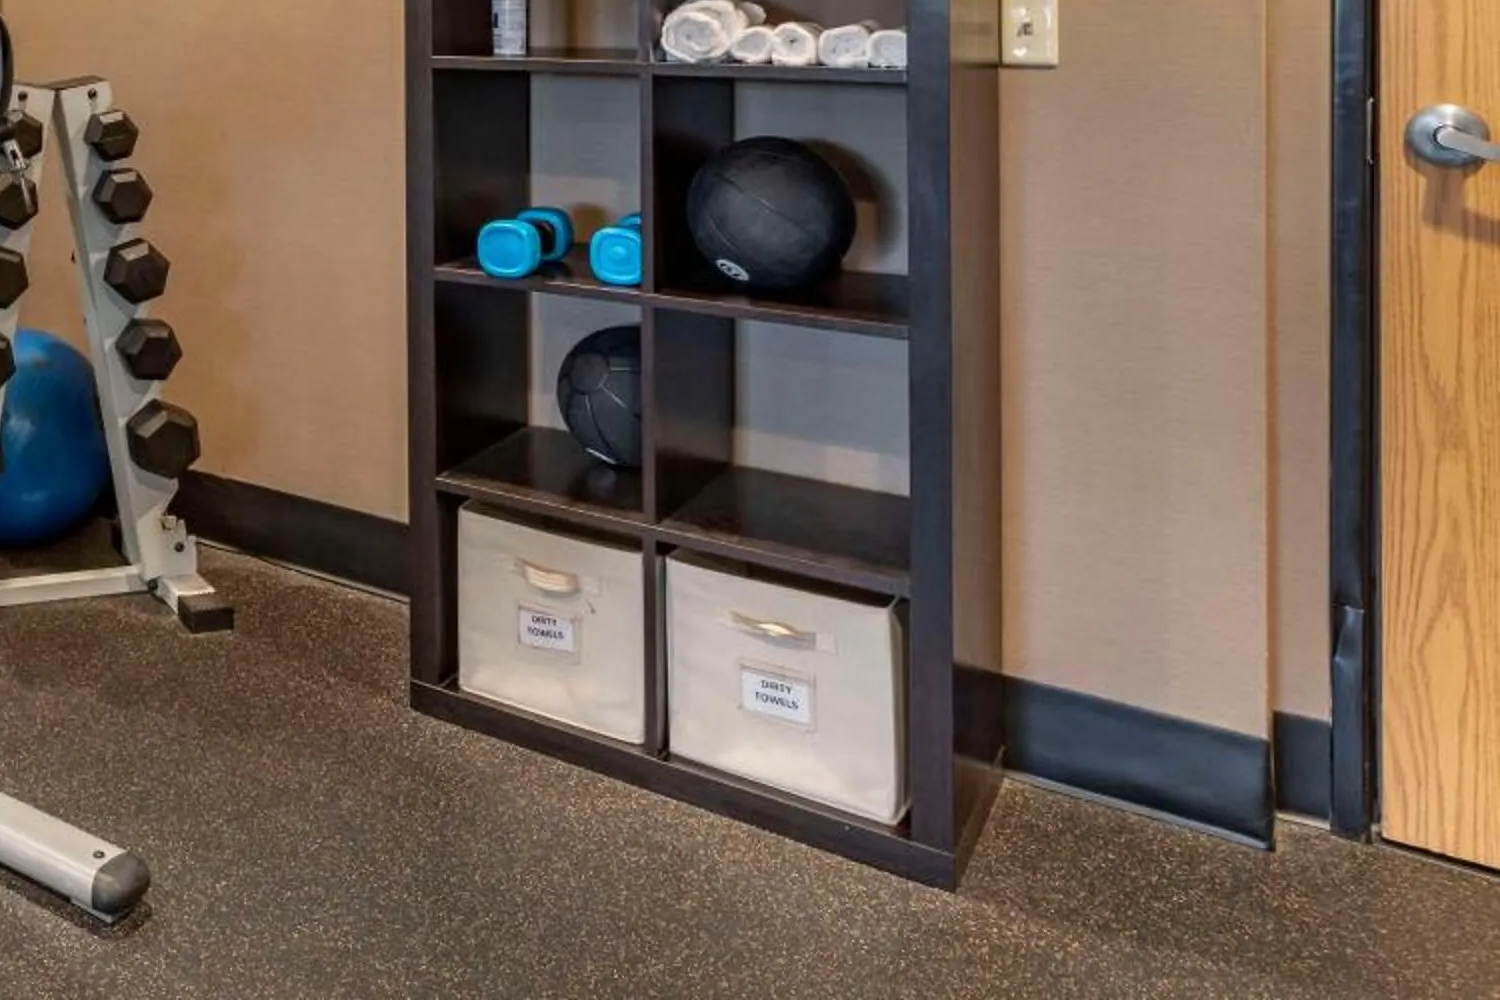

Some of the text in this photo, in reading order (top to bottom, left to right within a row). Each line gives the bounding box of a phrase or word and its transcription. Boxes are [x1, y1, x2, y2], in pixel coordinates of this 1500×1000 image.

[531, 615, 557, 626] DIRTY
[527, 626, 565, 640] TOWELS
[761, 679, 792, 695] DIRTY
[755, 691, 800, 709] TOWELS
